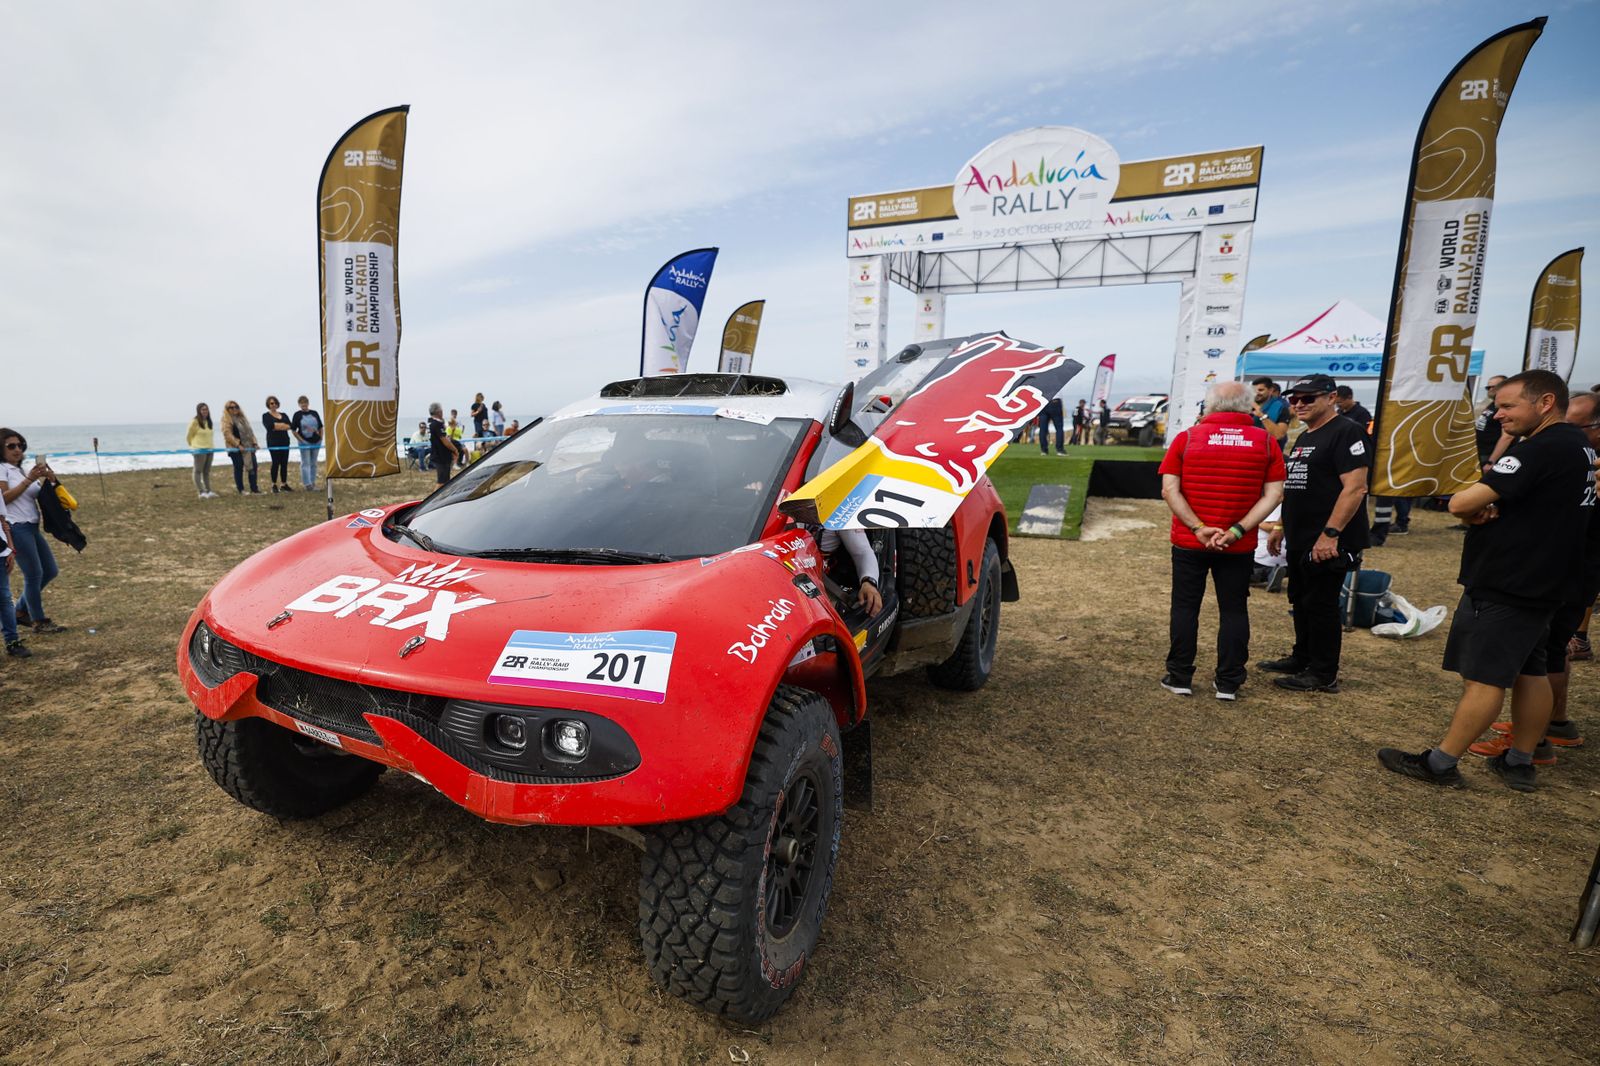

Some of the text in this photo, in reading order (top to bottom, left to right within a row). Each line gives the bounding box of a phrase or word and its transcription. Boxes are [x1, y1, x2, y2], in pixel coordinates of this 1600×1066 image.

[1460, 80, 1488, 100] 2R
[964, 150, 1108, 196] Andalucía
[1163, 162, 1195, 187] 2R
[1198, 170, 1254, 183] CHAMPIONSHIP
[1199, 163, 1253, 176] RALLY-RAID
[853, 201, 877, 221] 2R
[992, 187, 1077, 217] RALLY
[1104, 206, 1174, 226] Andalucía
[993, 228, 1005, 239] 23
[1007, 221, 1062, 237] OCTOBER
[1064, 219, 1092, 232] 2022
[1439, 219, 1460, 269] WORLD
[344, 257, 354, 296] WORLD
[1453, 213, 1482, 314] RALLY-RAID
[1469, 210, 1489, 315] CHAMPIONSHIP
[355, 254, 368, 333] RALLY-RAID
[368, 251, 380, 334] CHAMPIONSHIP
[675, 276, 699, 288] RALLY
[345, 340, 381, 387] 2R
[1426, 324, 1476, 383] 2R
[784, 536, 806, 551] Loeb
[285, 574, 497, 641] BRX
[573, 641, 606, 650] RALLY
[727, 598, 796, 664] Bahrain
[502, 655, 528, 669] 2R
[530, 660, 570, 668] RALLY-RAID
[586, 652, 647, 684] 201
